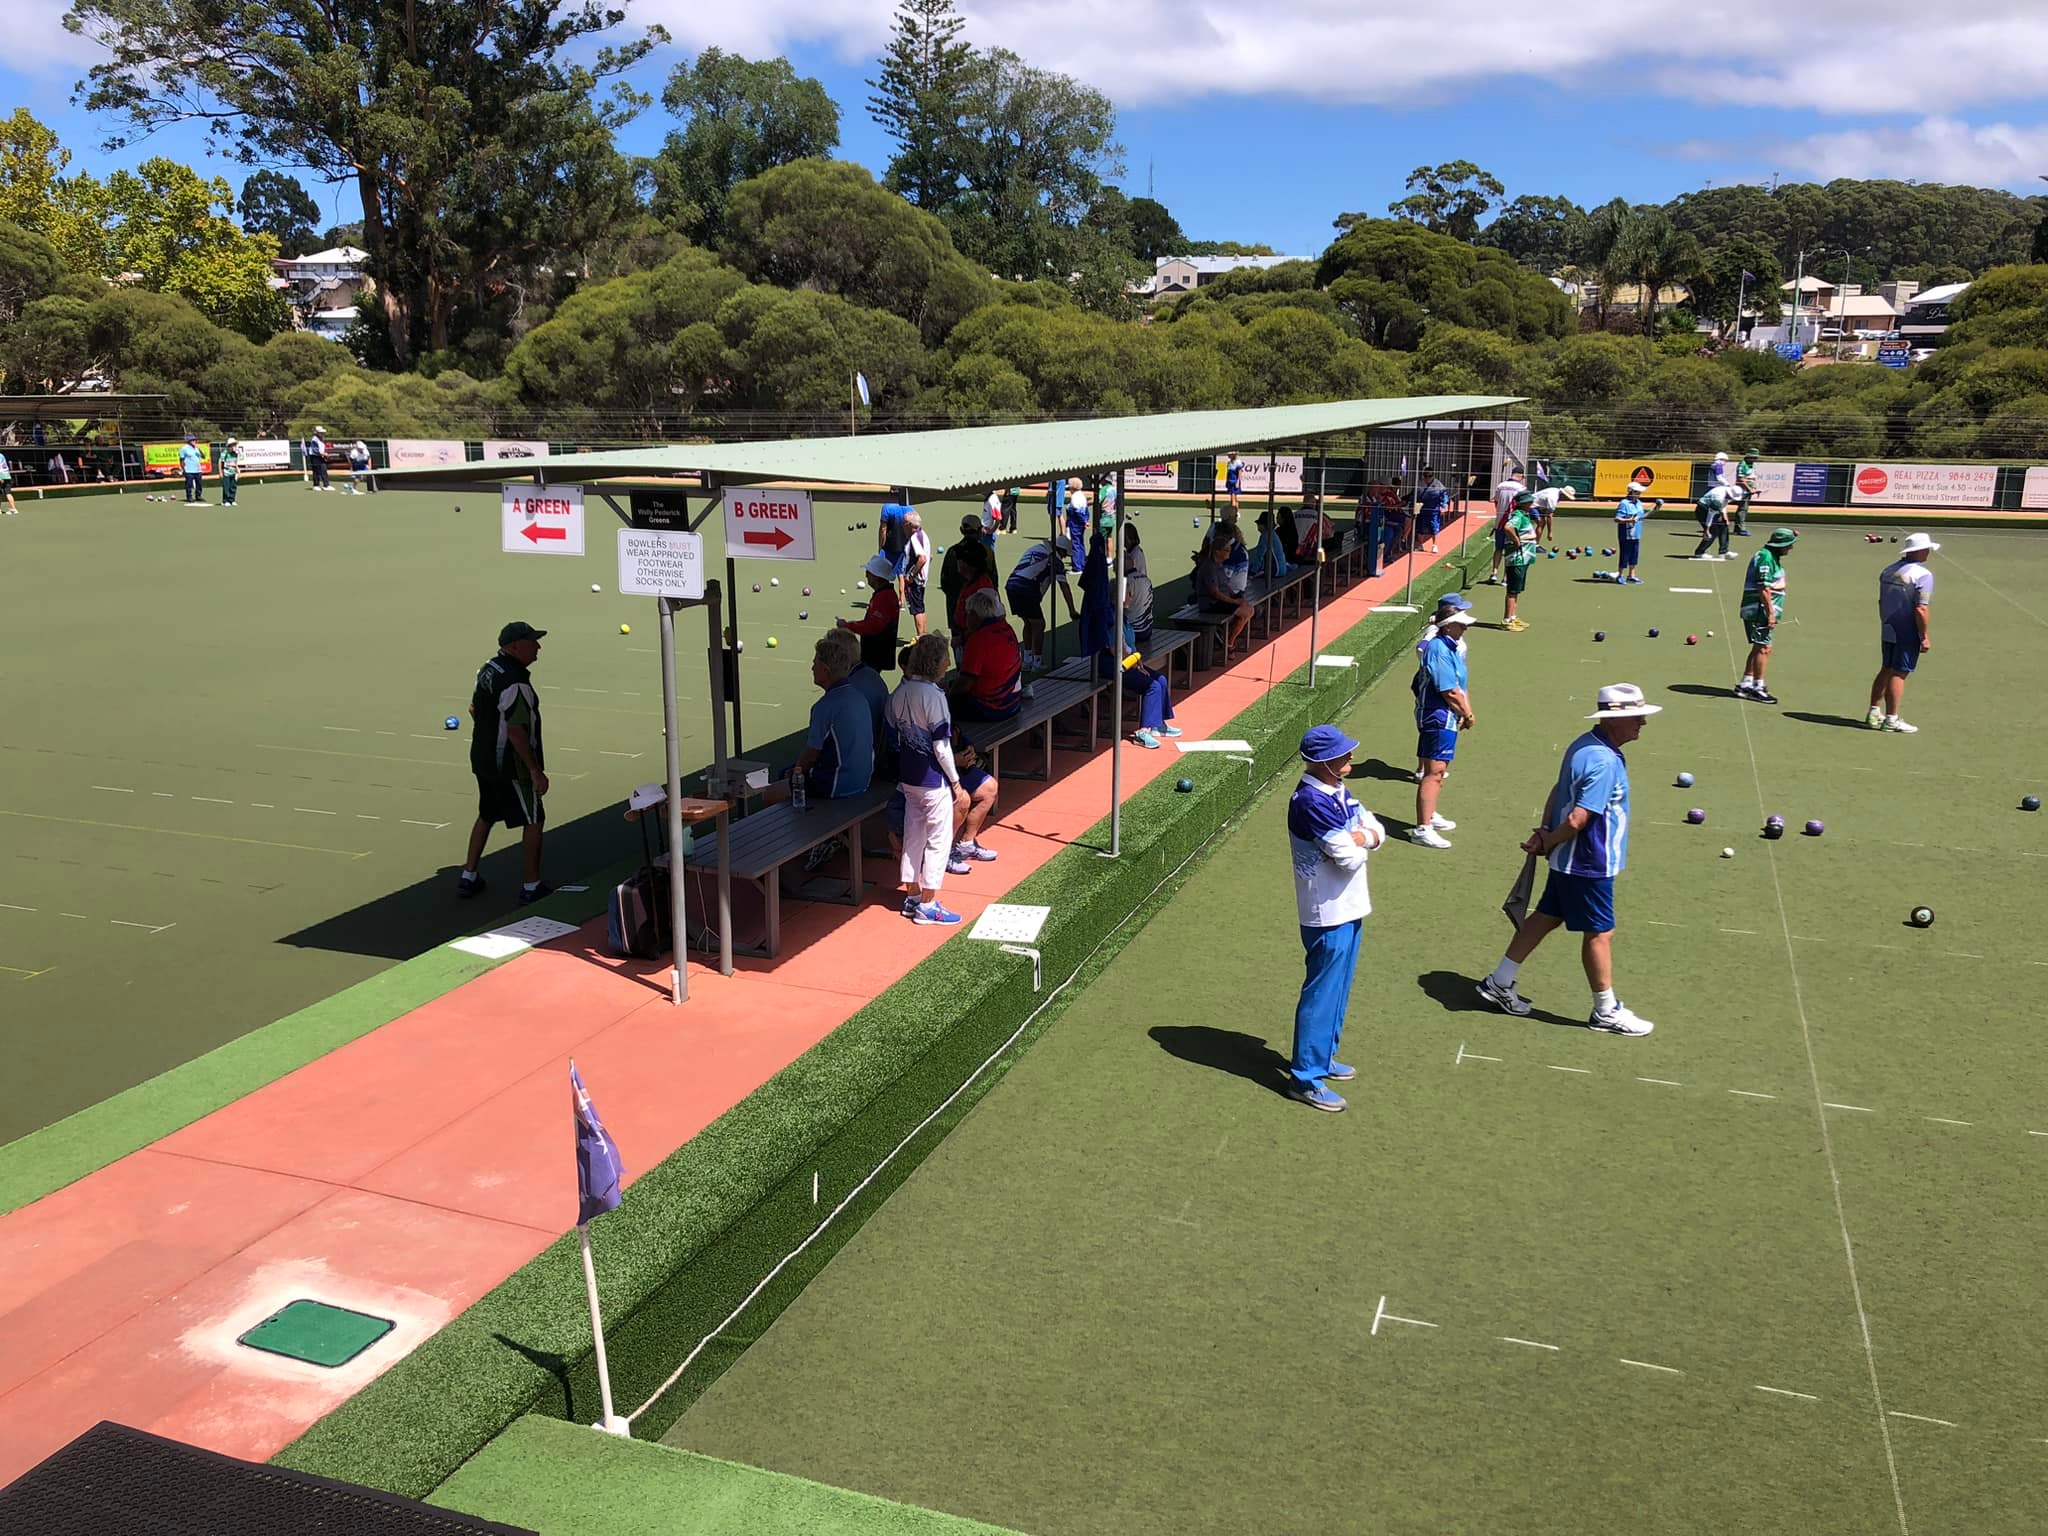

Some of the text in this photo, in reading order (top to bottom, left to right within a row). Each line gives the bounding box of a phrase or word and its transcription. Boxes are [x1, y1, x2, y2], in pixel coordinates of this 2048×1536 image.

[1599, 472, 1689, 481] Artisan Brewing
[1895, 470, 1912, 480] REAL
[1915, 471, 1940, 481] PIZZA
[1941, 494, 1959, 502] Street
[512, 497, 571, 516] A GREEN
[734, 501, 799, 520] B GREEN
[628, 539, 691, 551] BOWLERS MUST
[626, 548, 694, 560] WEAR APPROVED
[637, 558, 684, 569] FOOTWEAR
[636, 568, 685, 579] OTHERWISE
[635, 577, 688, 588] SOCKS ONLY
